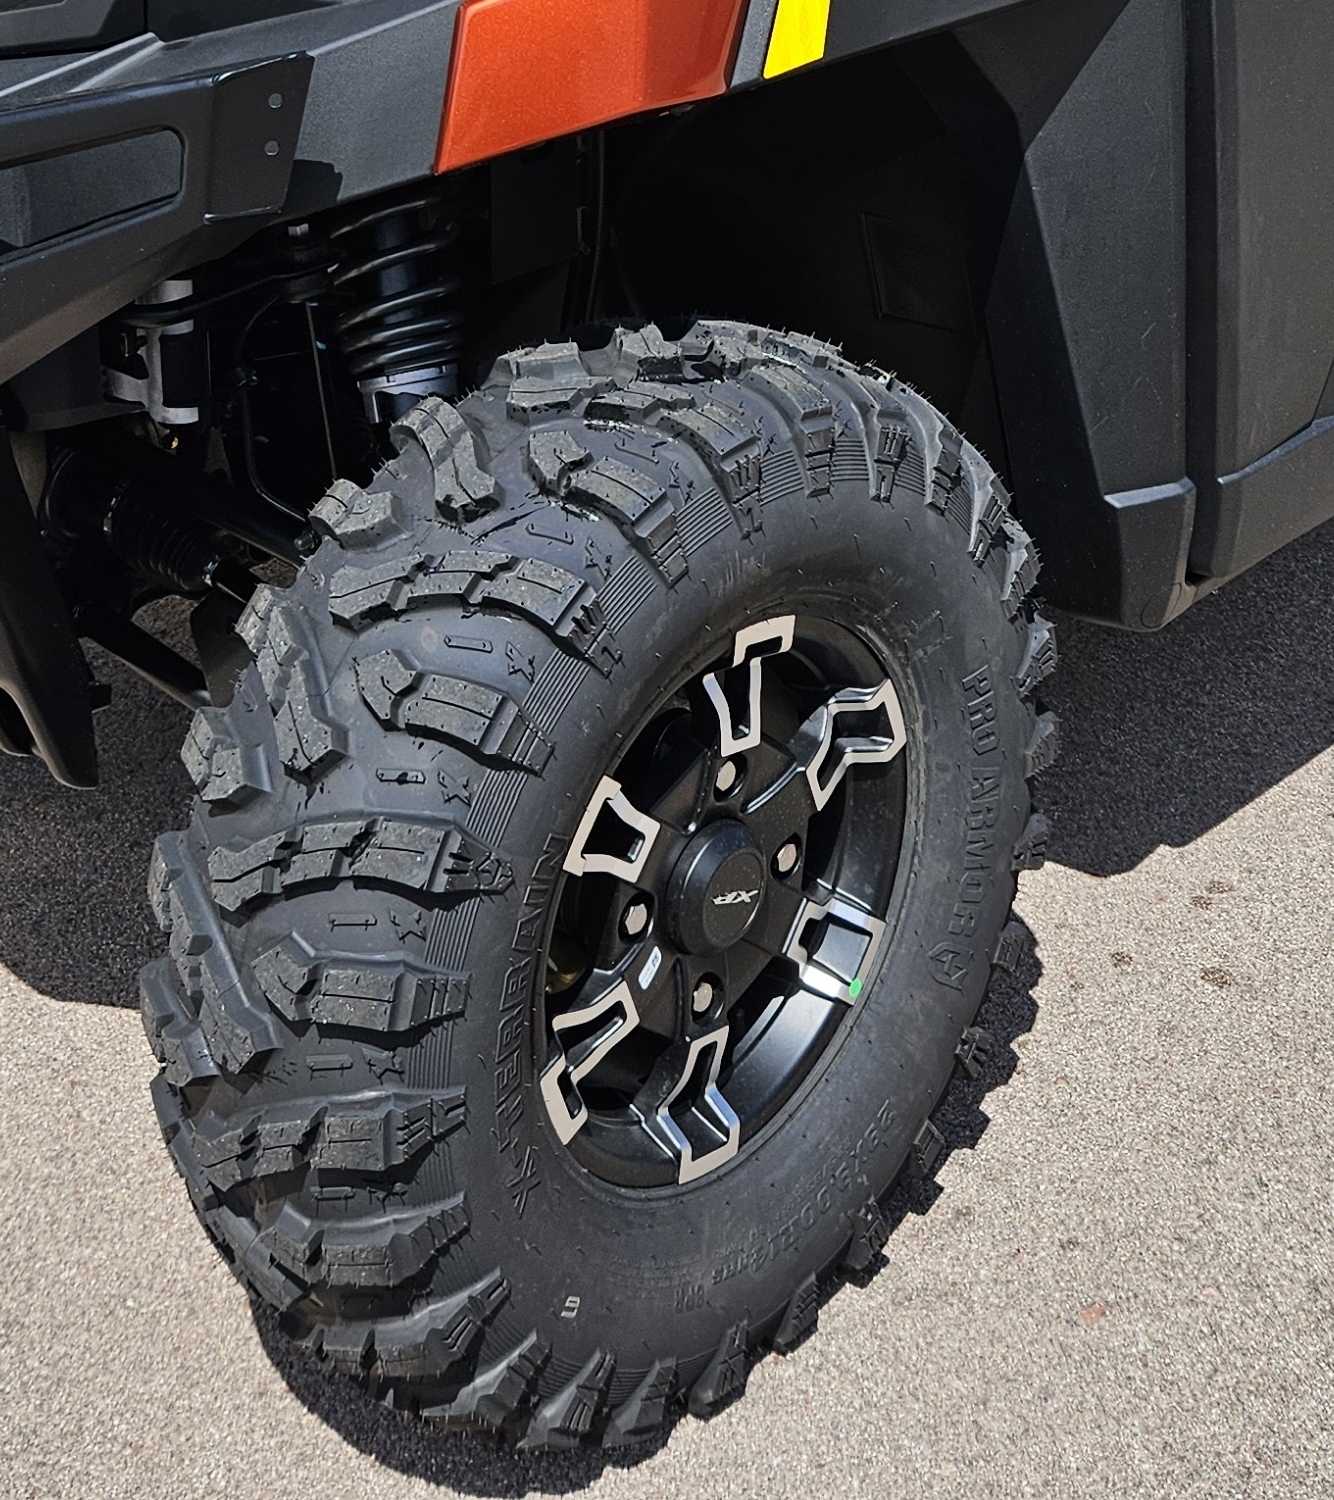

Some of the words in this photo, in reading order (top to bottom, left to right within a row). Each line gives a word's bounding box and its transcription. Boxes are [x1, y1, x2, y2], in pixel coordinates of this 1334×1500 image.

[961, 664, 1001, 757] PRO
[713, 889, 759, 905] XP
[948, 765, 1002, 939] ARMOR
[493, 833, 569, 1220] X-TERRAIN
